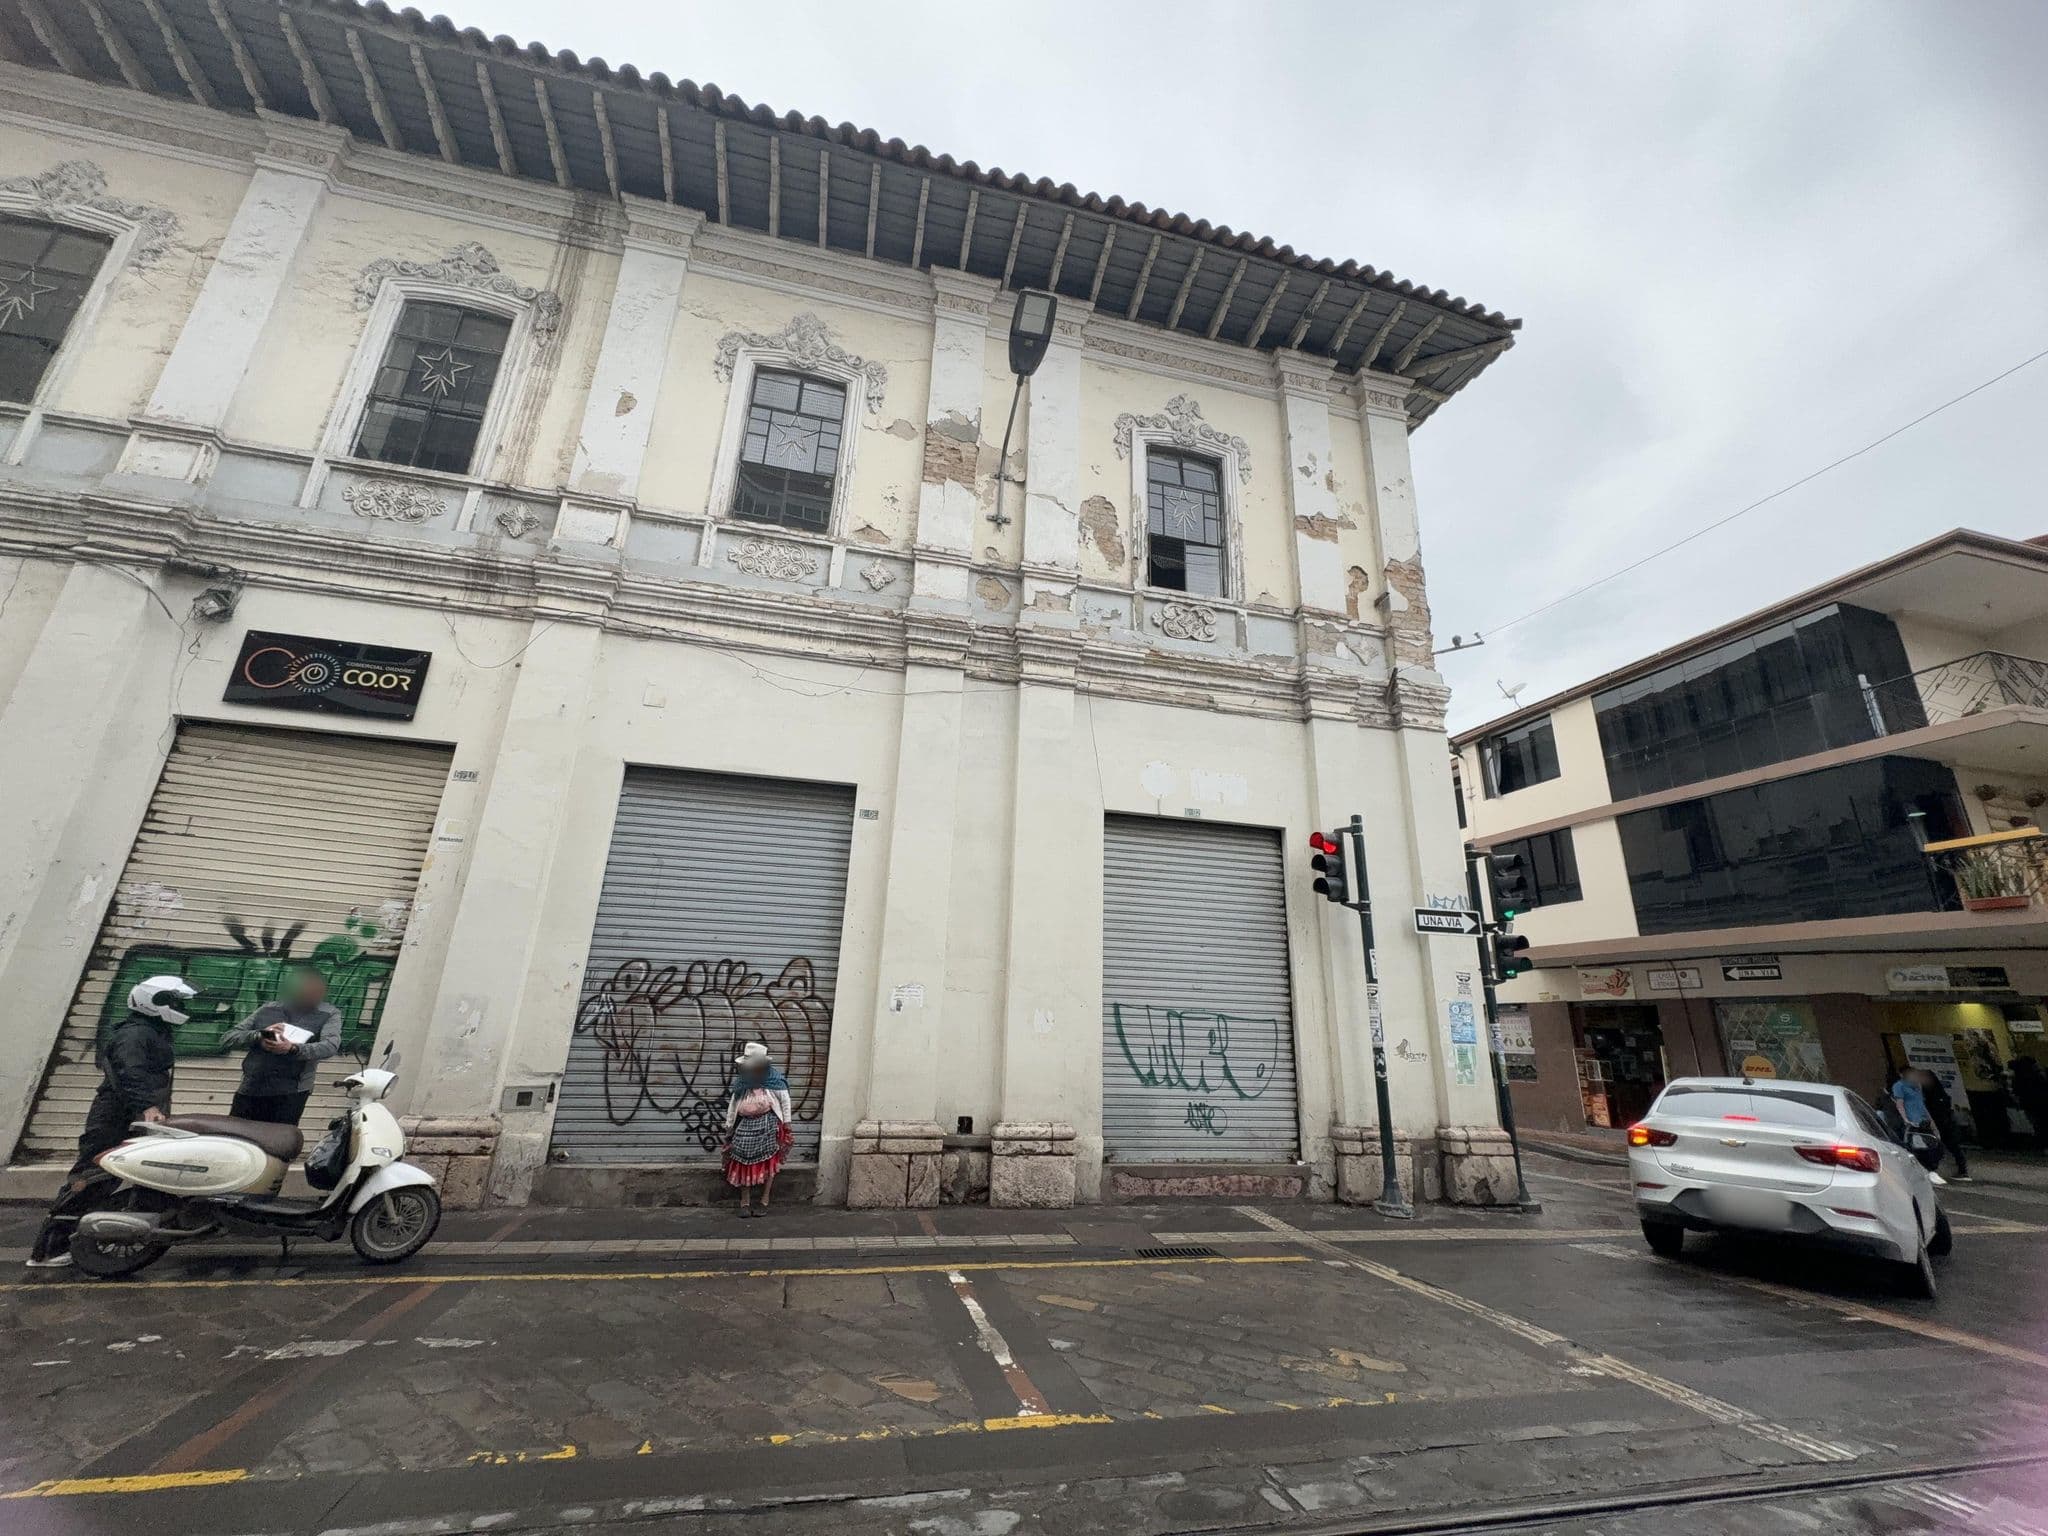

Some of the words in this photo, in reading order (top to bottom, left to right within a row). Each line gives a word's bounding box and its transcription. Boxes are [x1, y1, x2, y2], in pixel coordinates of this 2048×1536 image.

[346, 661, 383, 671] COMERCIAL
[1423, 916, 1443, 926] UNA
[1445, 917, 1463, 927] VIA
[1739, 969, 1755, 977] UNA
[1760, 968, 1776, 976] VIA
